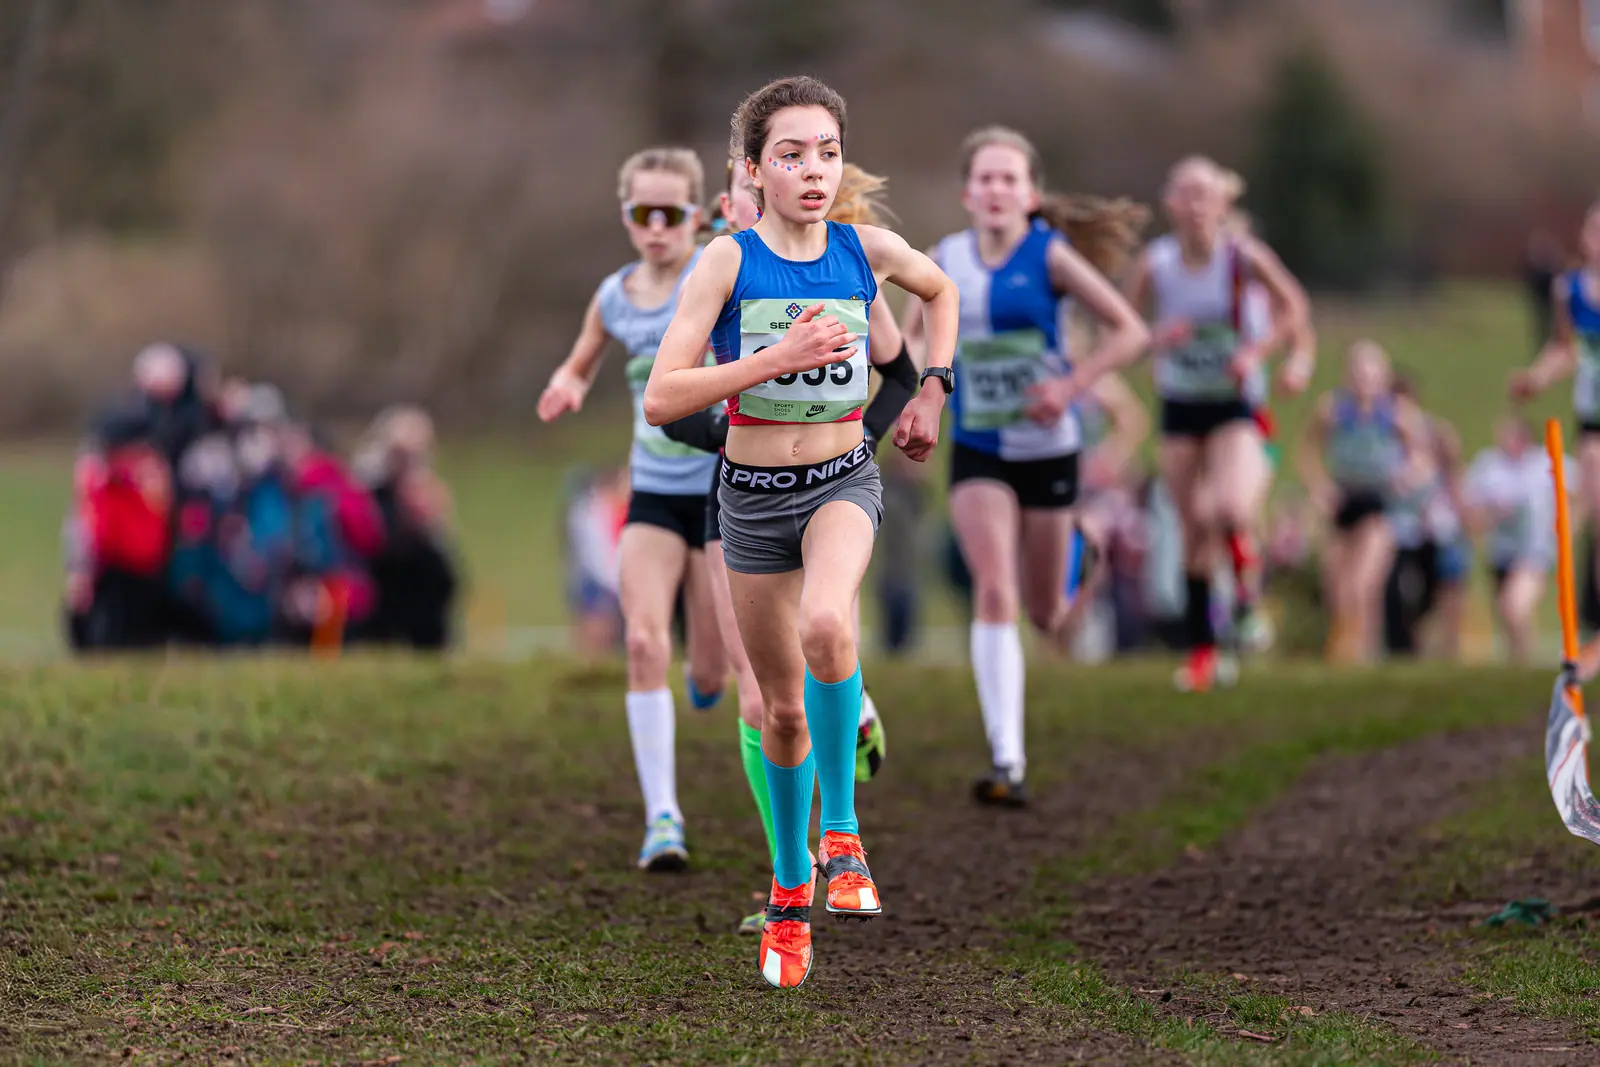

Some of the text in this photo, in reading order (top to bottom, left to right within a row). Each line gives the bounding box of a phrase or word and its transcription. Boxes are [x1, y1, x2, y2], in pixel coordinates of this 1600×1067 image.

[769, 321, 792, 330] SED
[810, 404, 827, 412] RUN
[731, 468, 797, 489] PRO
[805, 441, 866, 485] NIKE
